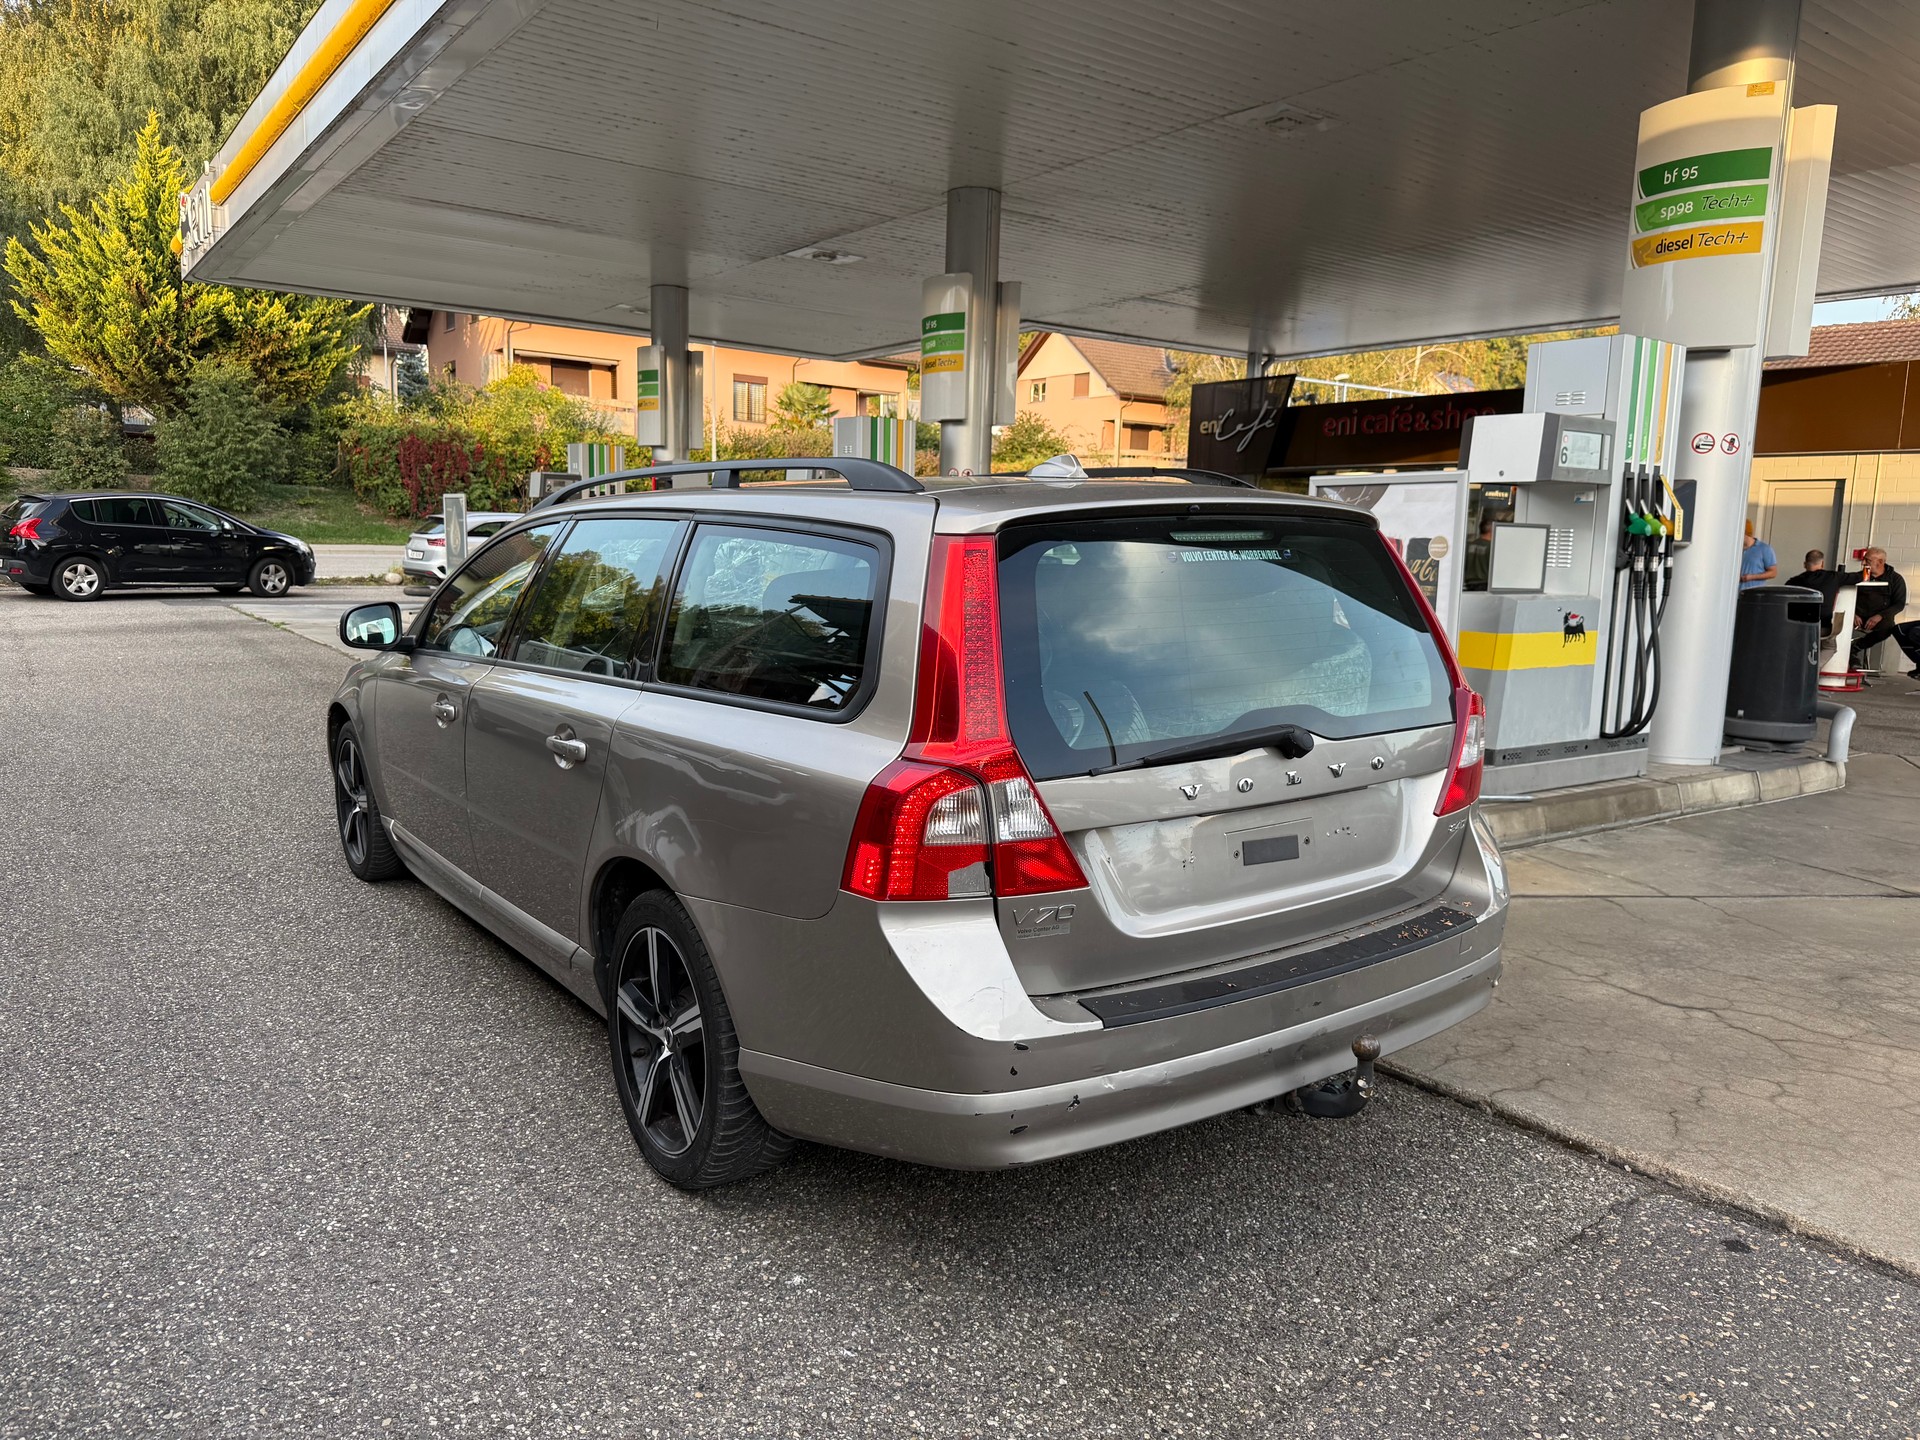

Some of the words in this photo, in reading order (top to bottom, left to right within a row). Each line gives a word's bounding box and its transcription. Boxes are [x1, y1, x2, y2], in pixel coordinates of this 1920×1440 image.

[1663, 167, 1679, 185] bf
[1681, 165, 1699, 181] 95
[1660, 201, 1694, 220] sp98
[1702, 193, 1754, 211] Tech+
[1655, 234, 1694, 254] diesel
[1697, 230, 1749, 248] Tech+
[1200, 415, 1222, 434] eni
[1322, 408, 1357, 437] eni
[1560, 446, 1568, 464] 6
[1180, 550, 1203, 562] VOLVO
[1203, 550, 1229, 561] CENTER
[1179, 756, 1385, 800] VOLVO
[1012, 903, 1077, 926] V70
